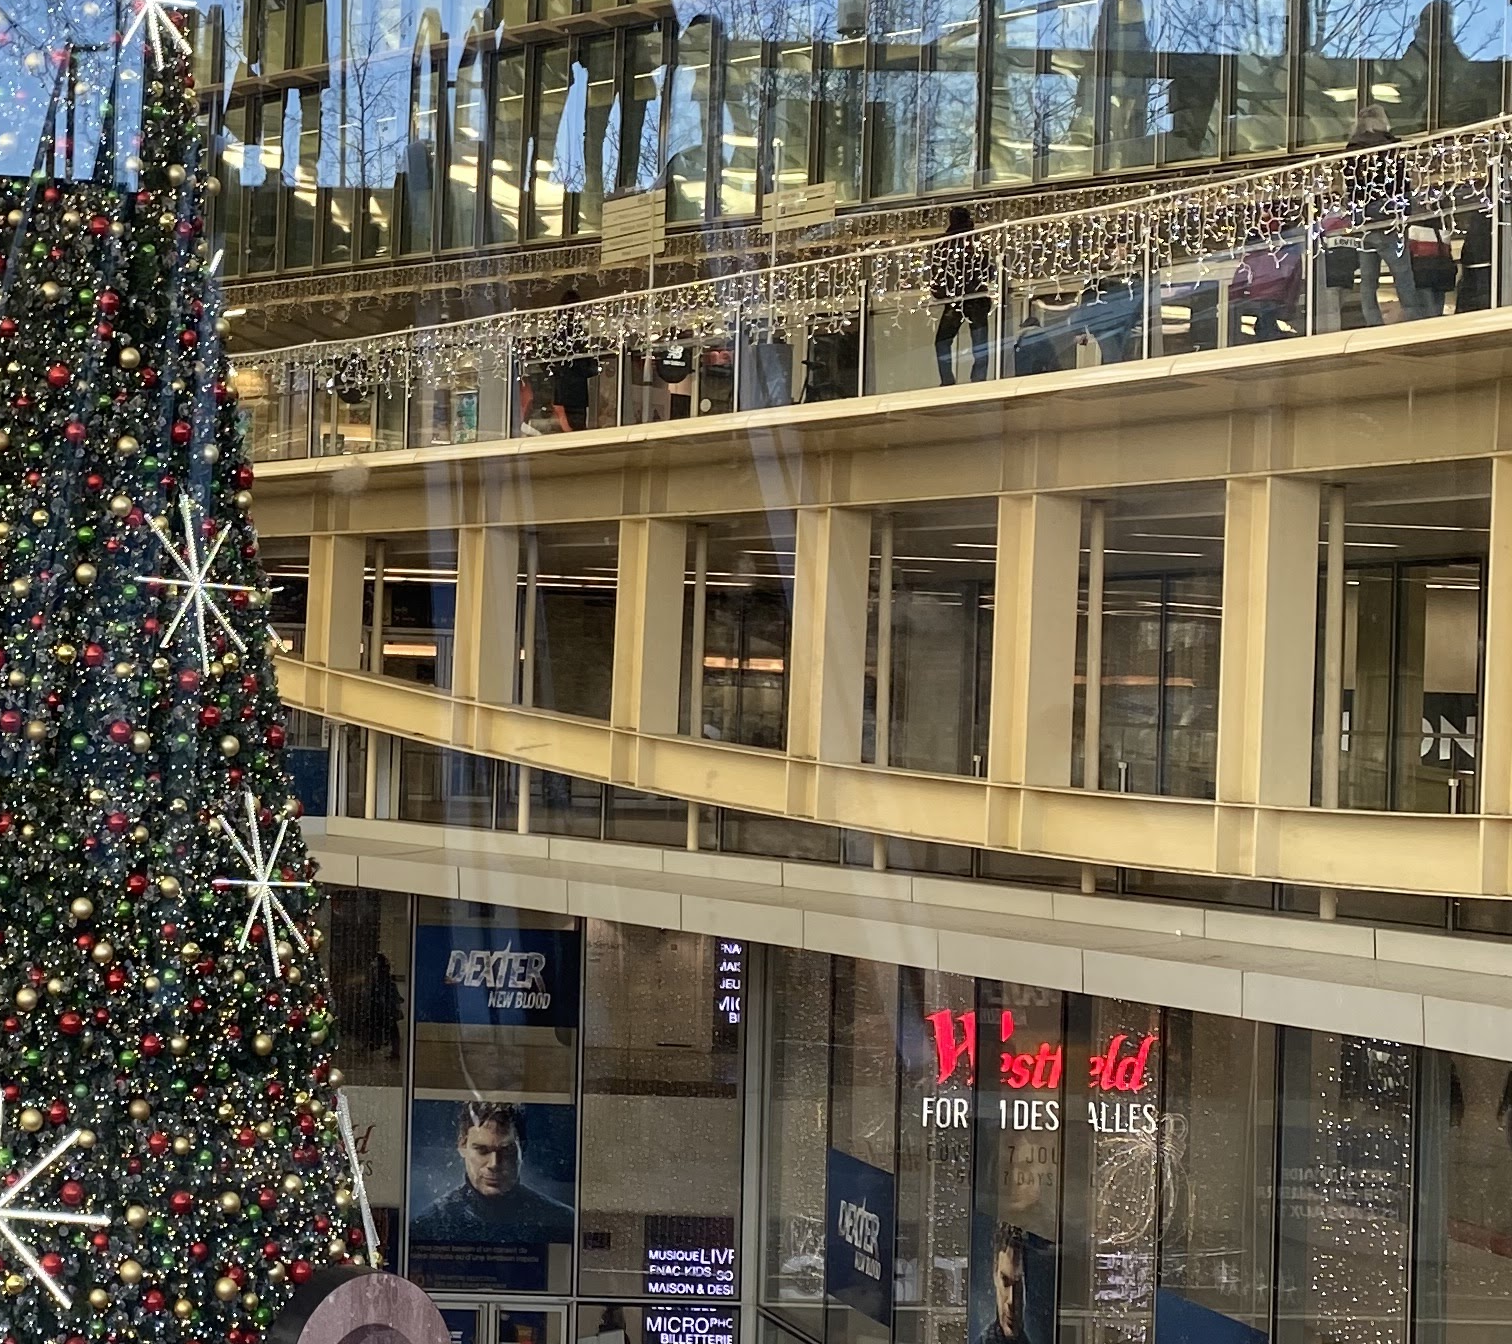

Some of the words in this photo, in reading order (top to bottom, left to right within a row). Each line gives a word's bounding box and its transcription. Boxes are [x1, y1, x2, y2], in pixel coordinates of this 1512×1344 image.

[444, 939, 546, 993] DEXTER
[488, 990, 514, 1009] NEW
[514, 992, 551, 1010] BLOOD
[1013, 1099, 1060, 1131] DES
[1087, 1101, 1159, 1134] ALLES
[838, 1197, 881, 1262] DEXTER
[648, 1249, 700, 1262] MUSIQUE
[648, 1282, 695, 1294] MAISON
[696, 1283, 705, 1295] &
